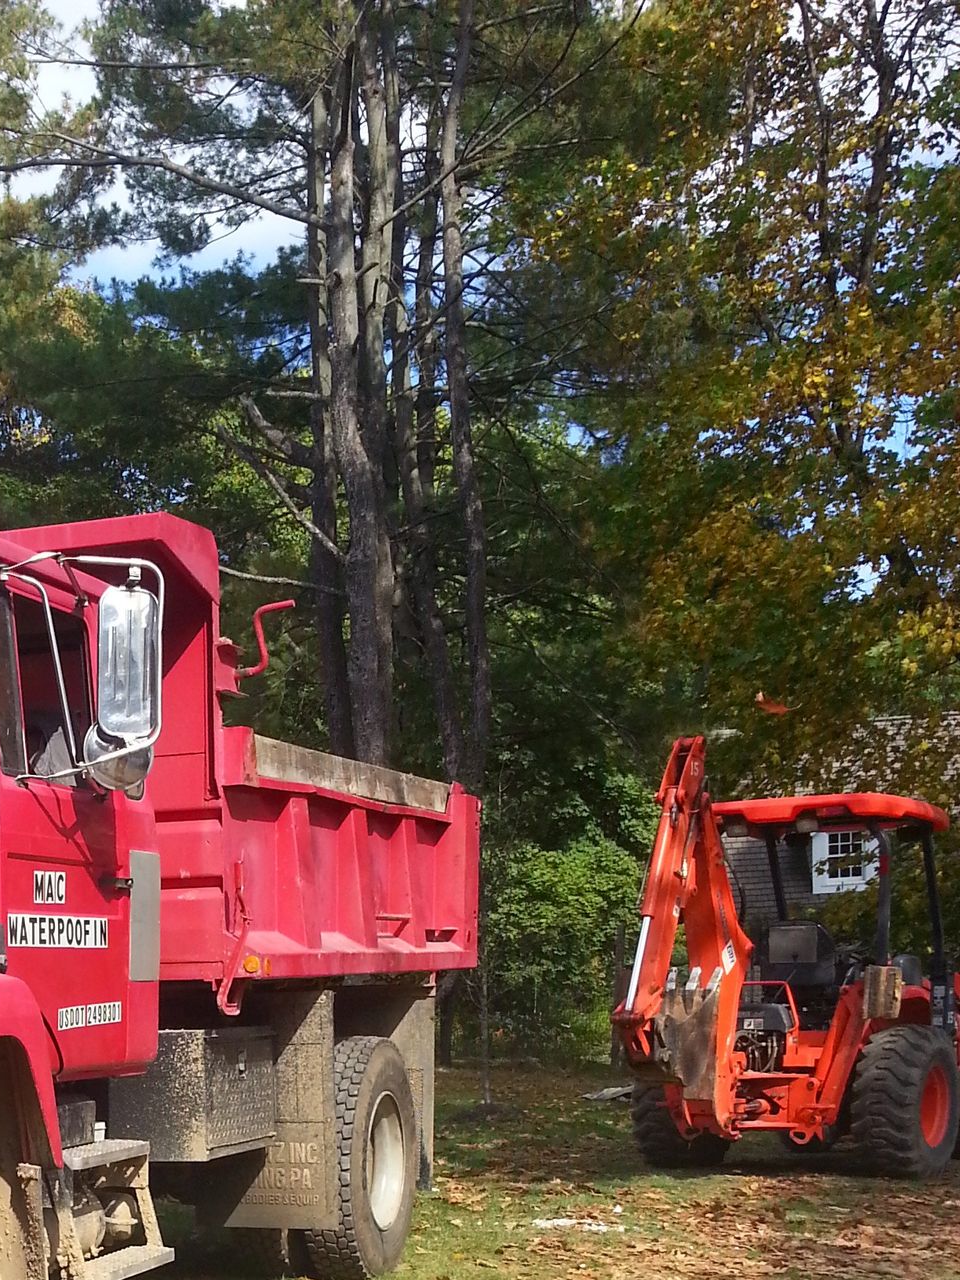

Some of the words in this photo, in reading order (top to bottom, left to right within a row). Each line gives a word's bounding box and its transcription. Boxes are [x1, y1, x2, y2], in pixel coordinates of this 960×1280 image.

[690, 760, 699, 777] 15
[34, 874, 64, 902] MAC
[8, 915, 107, 946] WATERPOOFIN
[59, 1007, 84, 1029] USDOT
[87, 1003, 120, 1024] 2498301
[289, 1142, 321, 1164] INC.
[255, 1167, 287, 1191] ING,
[246, 1193, 281, 1205] BODIES
[290, 1194, 320, 1207] EQUIP
